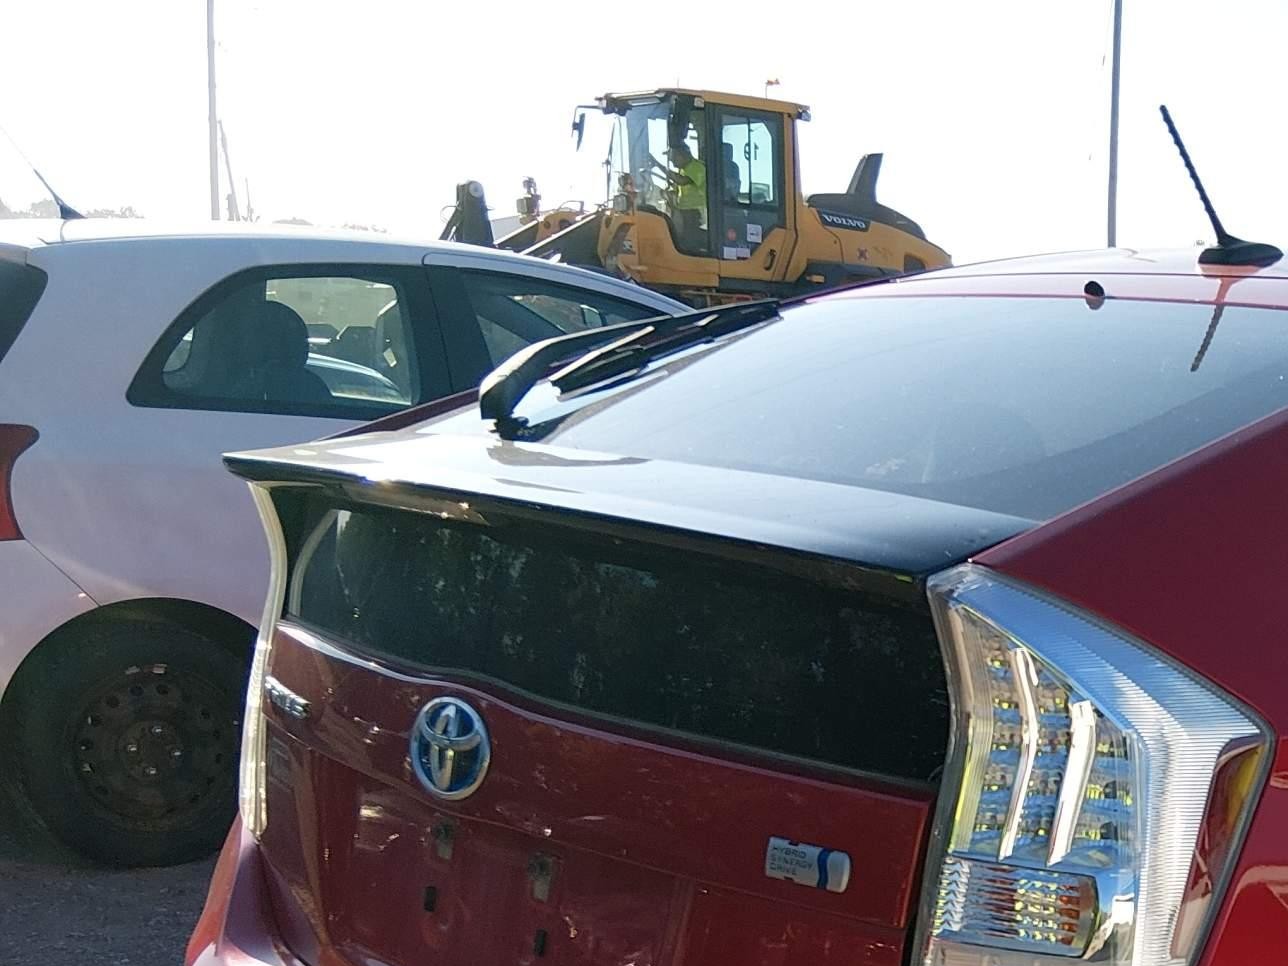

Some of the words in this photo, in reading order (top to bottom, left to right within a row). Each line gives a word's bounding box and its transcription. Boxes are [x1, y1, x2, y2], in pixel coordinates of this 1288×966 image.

[822, 214, 866, 229] VOLVO
[771, 844, 807, 859] HYBRID
[769, 862, 797, 876] DRIVE
[770, 853, 815, 871] SYNERGY
